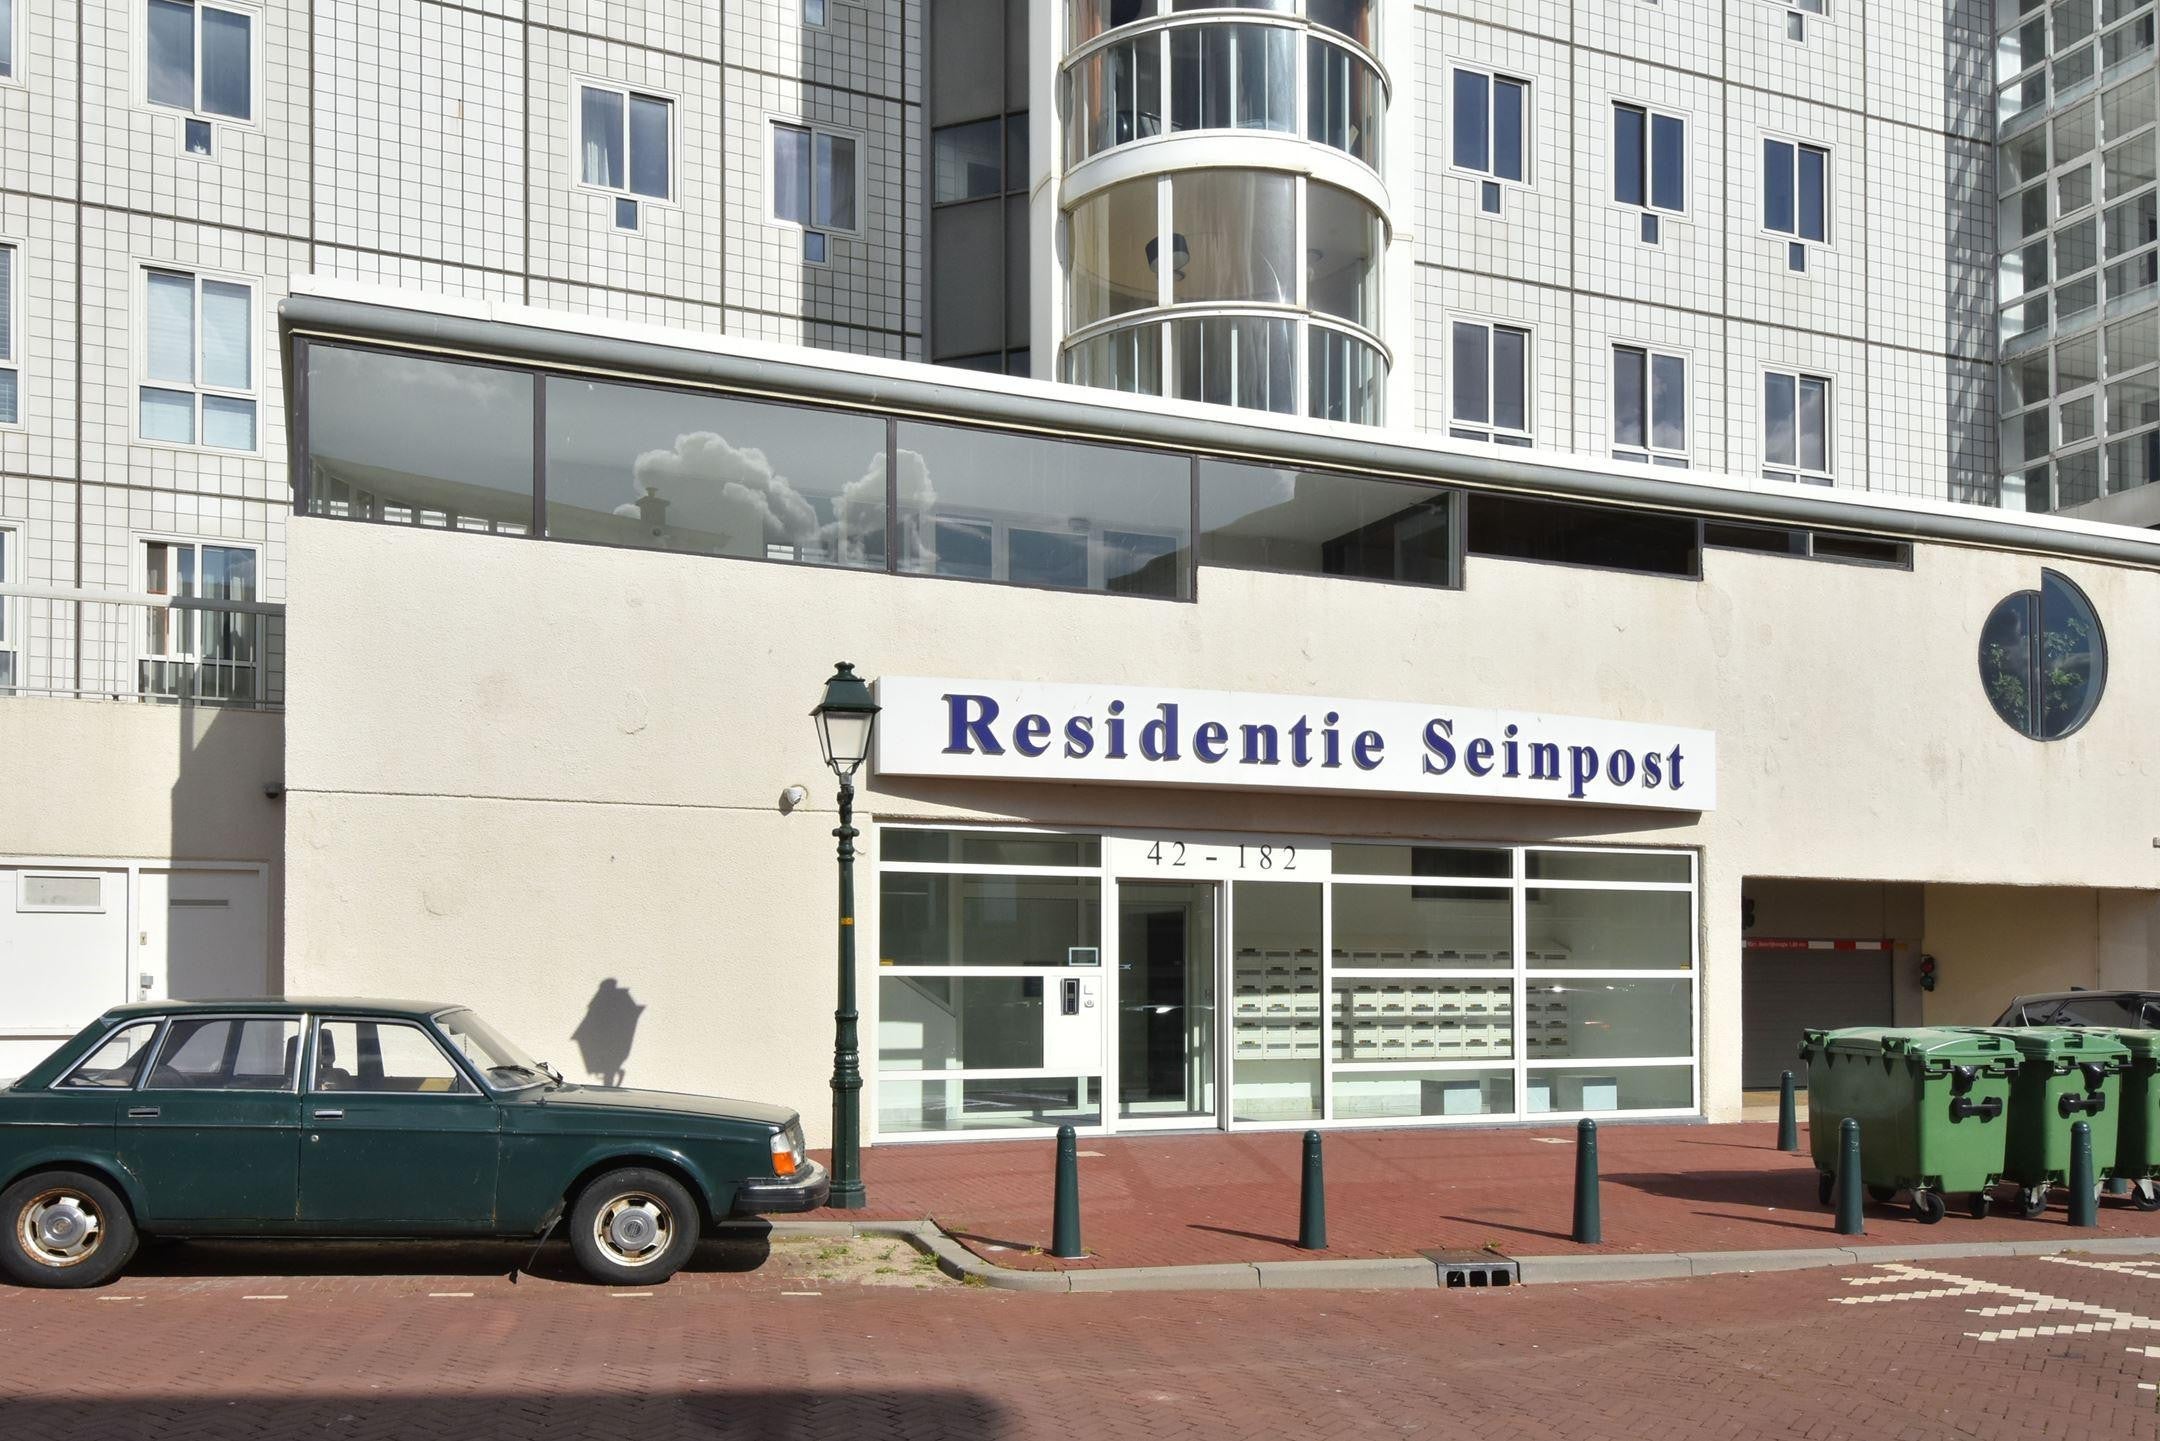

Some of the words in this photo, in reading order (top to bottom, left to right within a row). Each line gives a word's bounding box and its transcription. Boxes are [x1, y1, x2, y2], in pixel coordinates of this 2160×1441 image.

[942, 693, 1385, 770] Residentie
[1422, 718, 1685, 798] Seinpost
[1147, 841, 1187, 866] 42
[1238, 843, 1297, 870] 182
